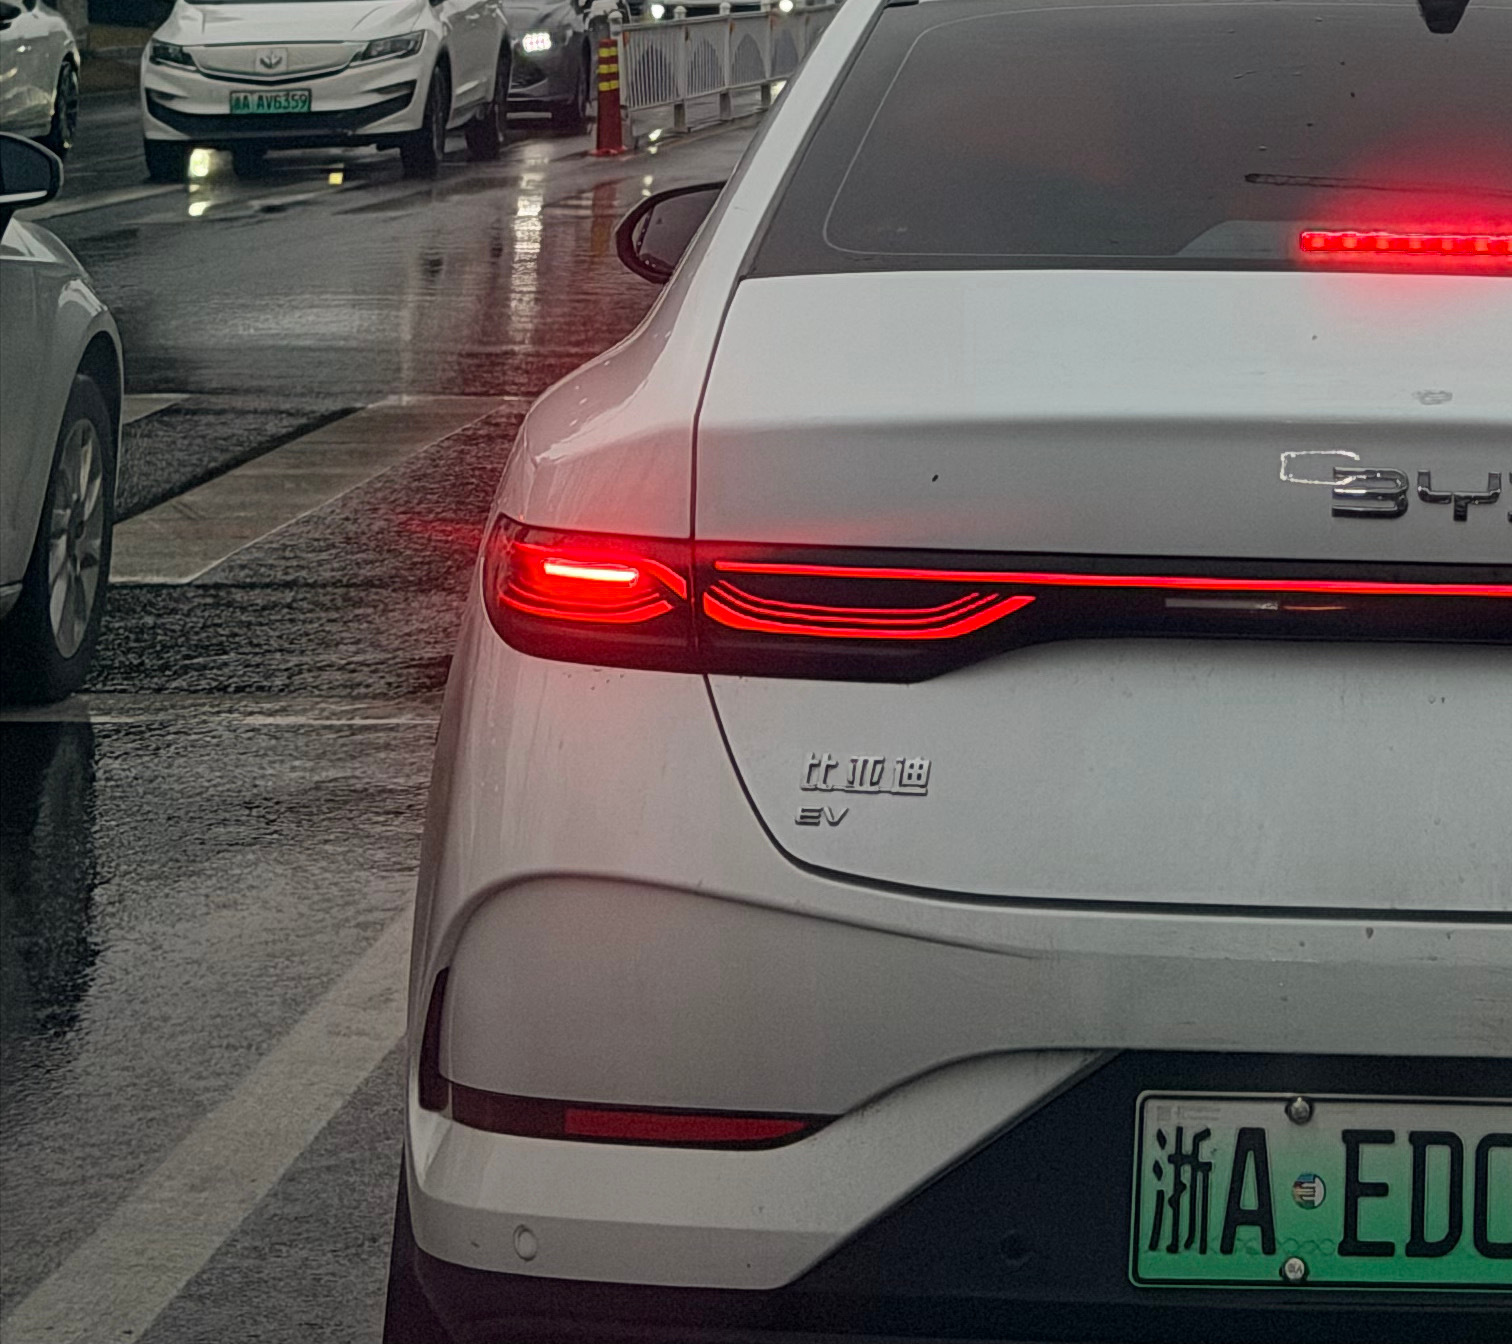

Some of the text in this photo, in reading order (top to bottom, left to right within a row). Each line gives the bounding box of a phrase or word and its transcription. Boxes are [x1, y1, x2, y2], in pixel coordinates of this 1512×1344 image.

[800, 751, 932, 797] 比亚迪
[795, 805, 850, 827] EV
